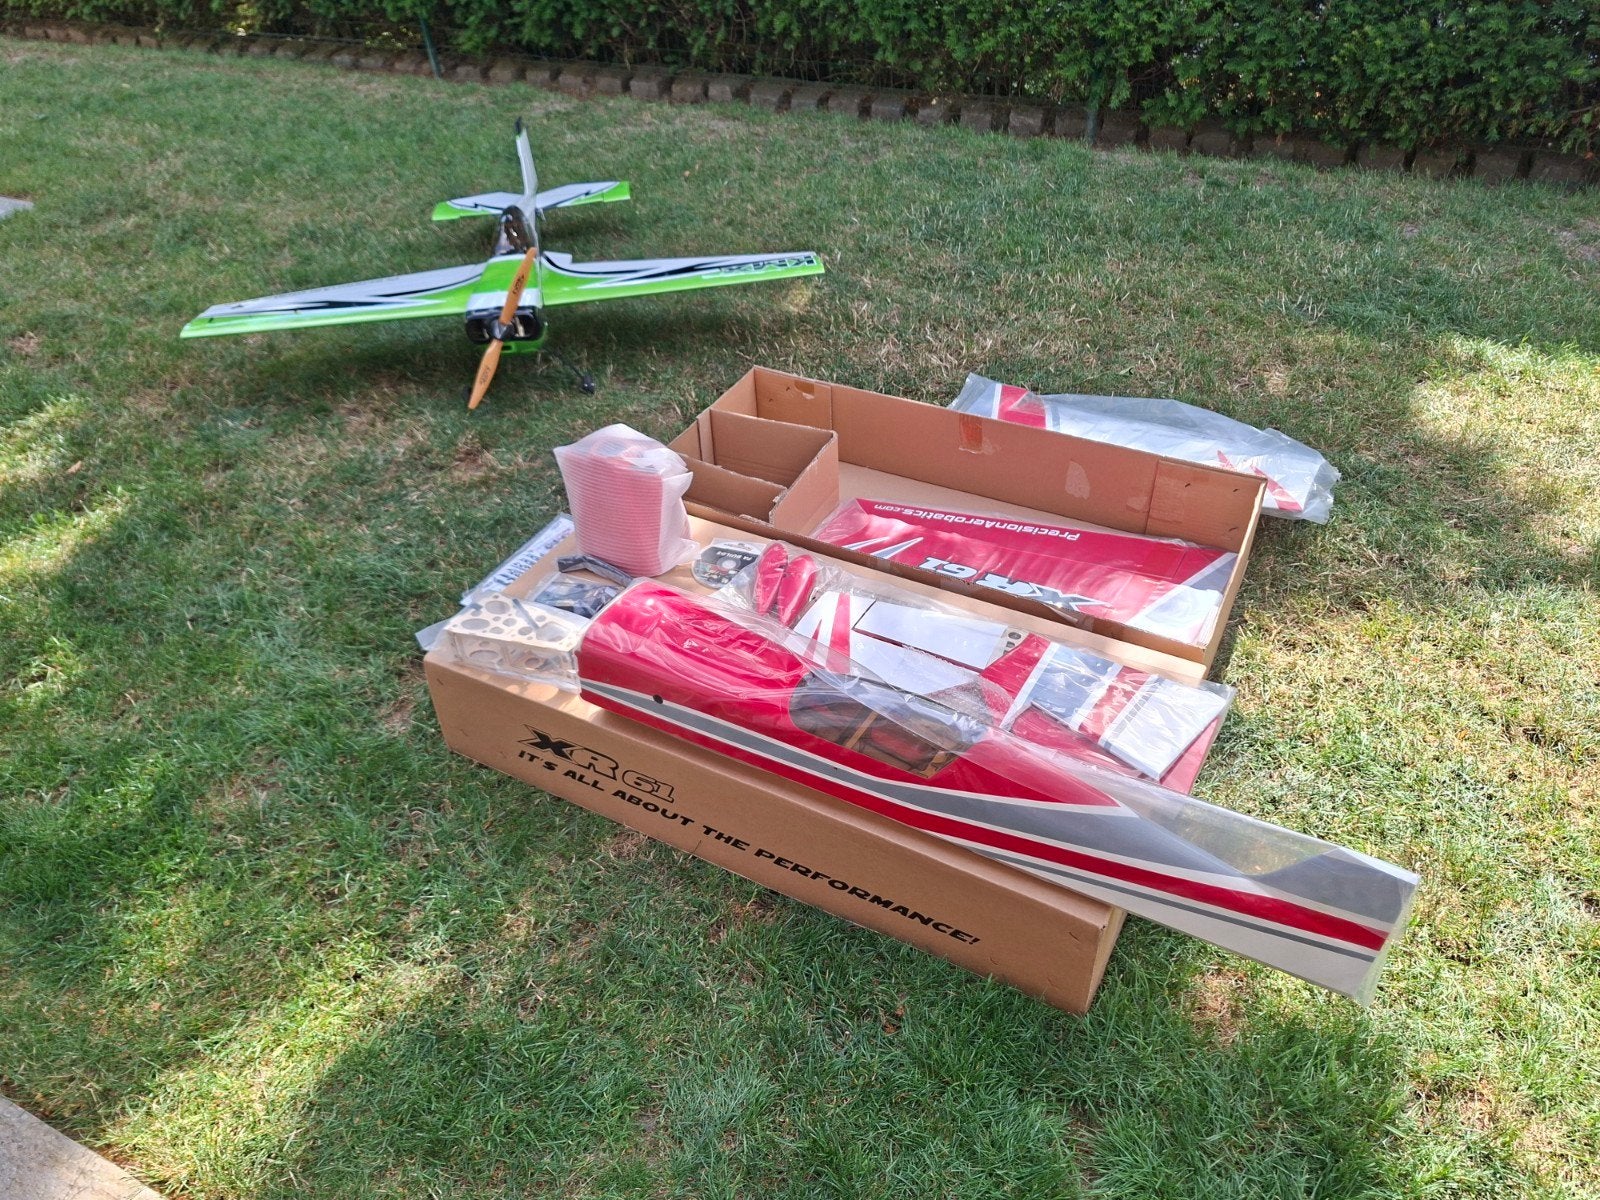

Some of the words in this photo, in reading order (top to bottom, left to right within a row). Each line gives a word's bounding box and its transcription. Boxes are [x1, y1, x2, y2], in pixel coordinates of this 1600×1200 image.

[873, 503, 1081, 541] PrecisionAerobatics.com
[918, 556, 979, 579] 61
[517, 724, 620, 781] XR
[621, 769, 675, 804] 61
[518, 749, 559, 772] IT'S
[562, 769, 605, 792] ALL
[611, 789, 695, 827] ABOUT
[702, 824, 751, 851] THE
[753, 848, 981, 946] PERFORMANCE!
